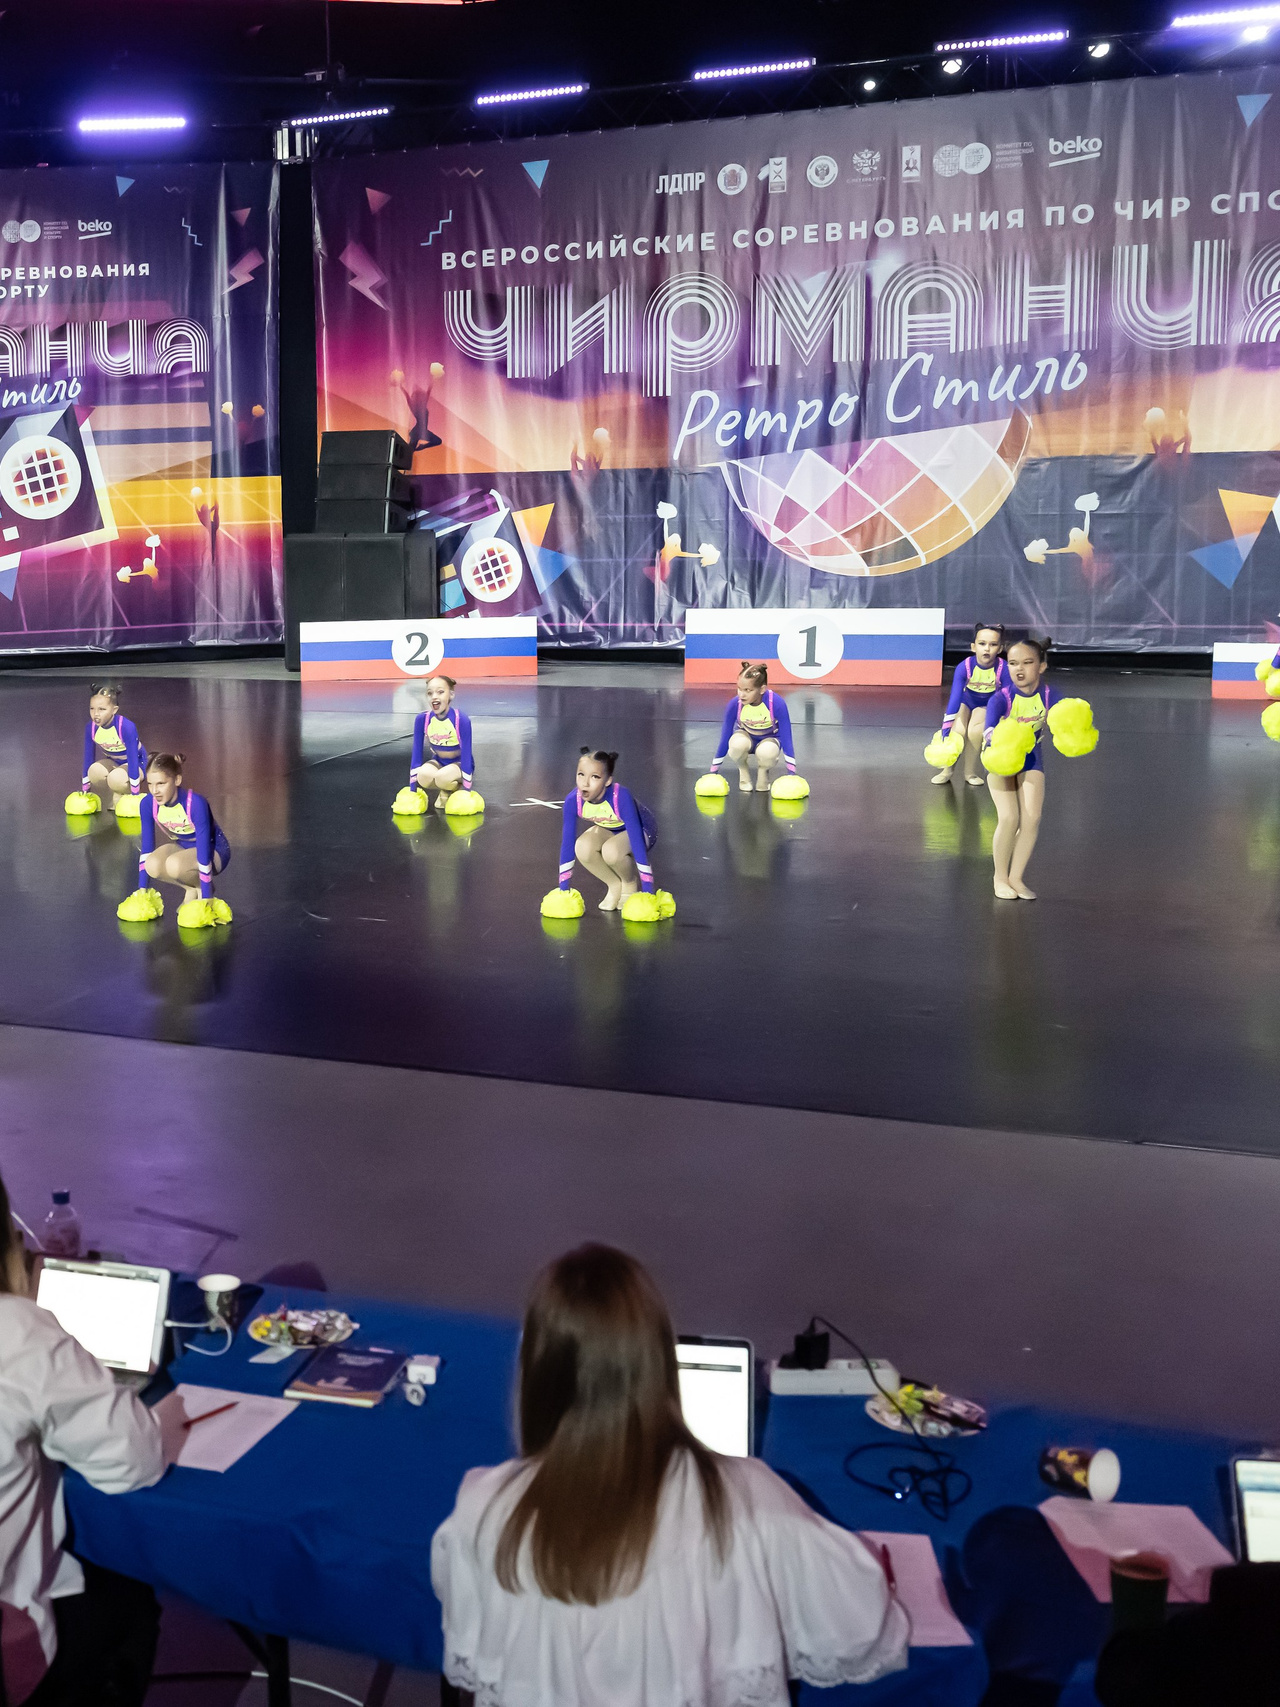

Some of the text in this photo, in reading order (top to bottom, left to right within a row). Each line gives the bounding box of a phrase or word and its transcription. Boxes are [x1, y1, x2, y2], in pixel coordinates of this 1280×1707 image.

[1049, 136, 1103, 155] beko
[655, 172, 706, 196] ЛДПР
[77, 219, 113, 233] beko
[440, 231, 717, 270] ВСЕРОССИЙСКИЕ
[731, 208, 1025, 249] СОРЕВНОВАНИЯ
[1045, 203, 1095, 226] ПО
[1114, 196, 1192, 221] ЧИР
[672, 351, 1089, 461] Ретро Стиль
[404, 631, 431, 666] 2
[797, 625, 823, 667] 1
